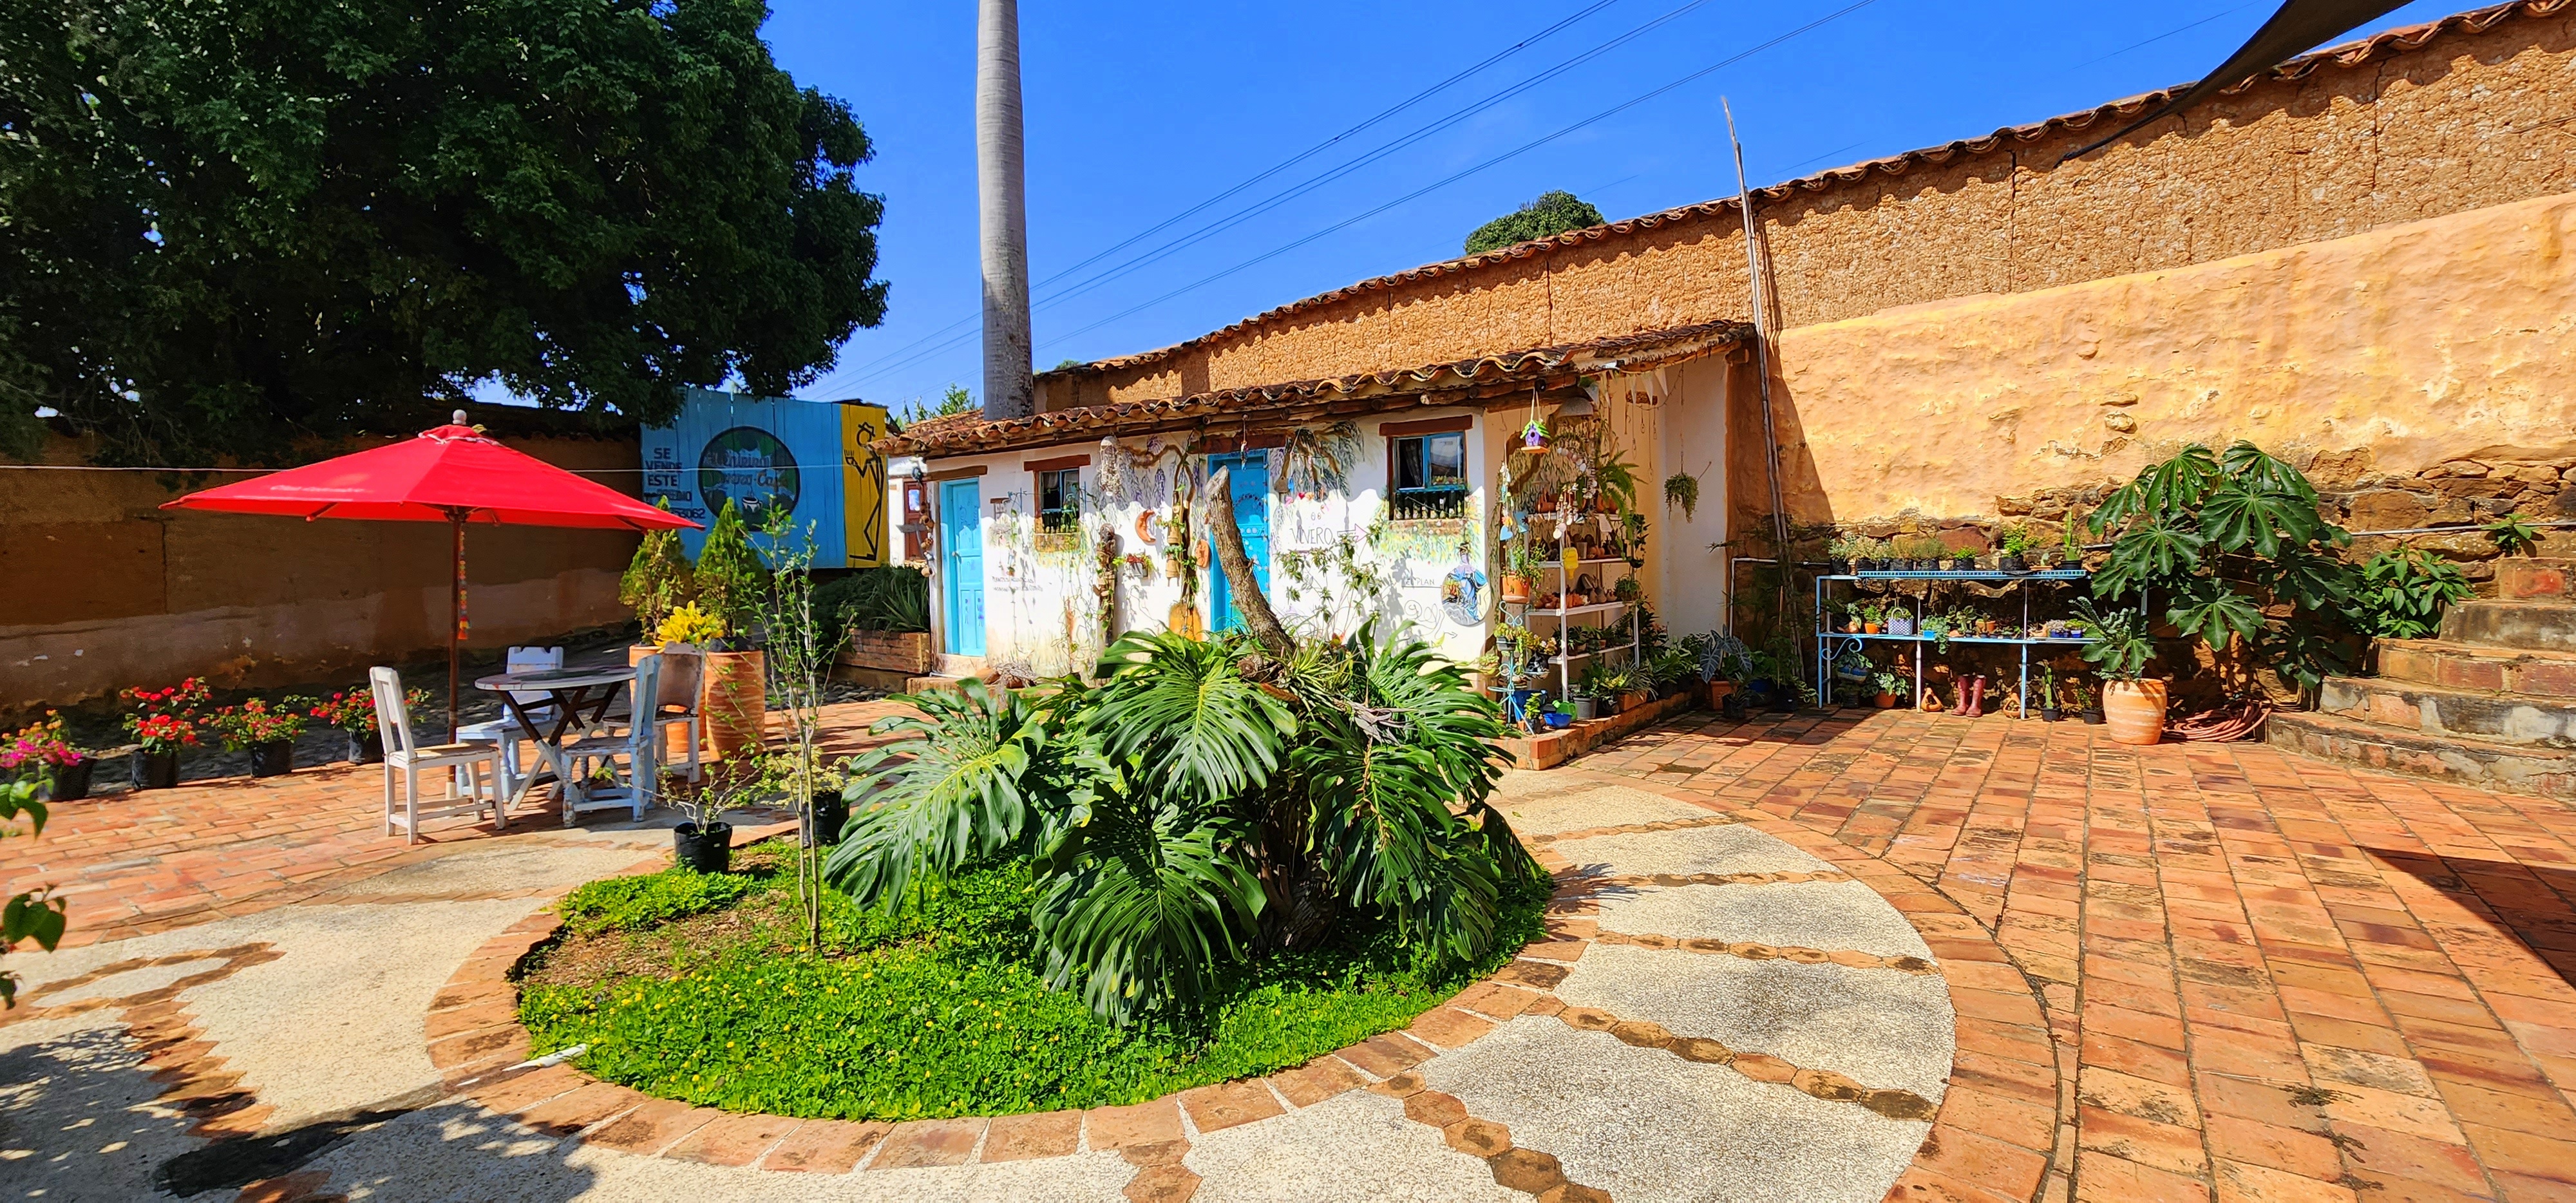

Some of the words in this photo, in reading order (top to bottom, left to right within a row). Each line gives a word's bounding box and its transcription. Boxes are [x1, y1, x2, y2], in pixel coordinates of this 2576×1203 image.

[654, 448, 671, 459] SE
[645, 460, 683, 473] VENDE
[648, 475, 677, 486] ESTE
[1289, 527, 1332, 545] VIVERO
[1417, 578, 1435, 586] PLAN
